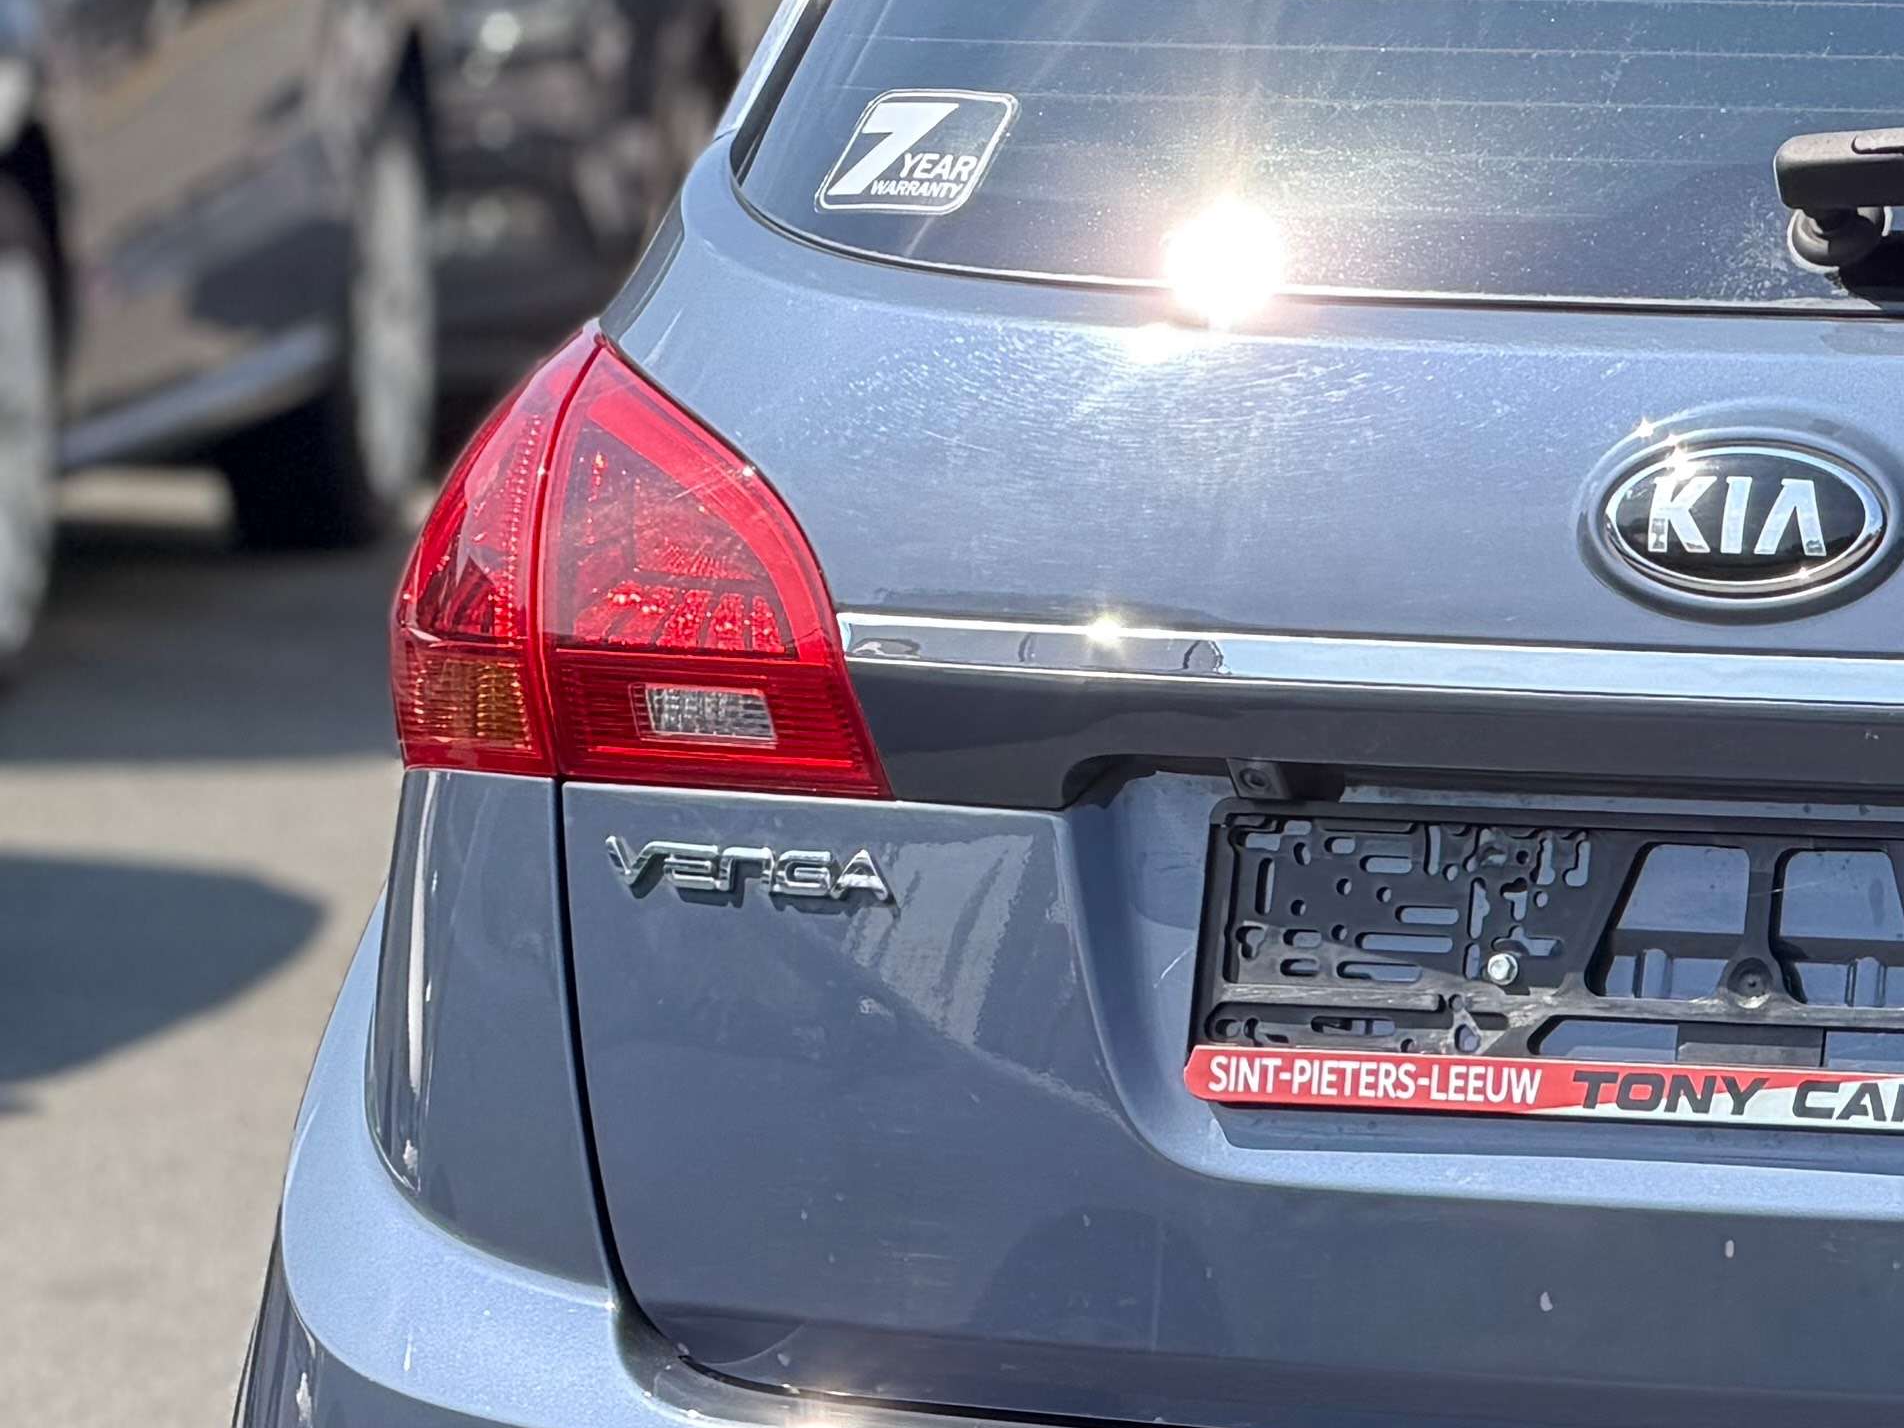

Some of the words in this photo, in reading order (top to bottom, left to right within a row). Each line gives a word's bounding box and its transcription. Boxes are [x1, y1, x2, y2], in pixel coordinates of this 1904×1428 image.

[826, 102, 959, 196] 7
[899, 152, 979, 182] YEAR
[869, 179, 964, 199] WARRANTY
[1647, 475, 1827, 557] KIA
[1208, 1054, 1542, 1104] SINT-PIETERS-LEEUW
[1573, 1070, 1770, 1117] TONY
